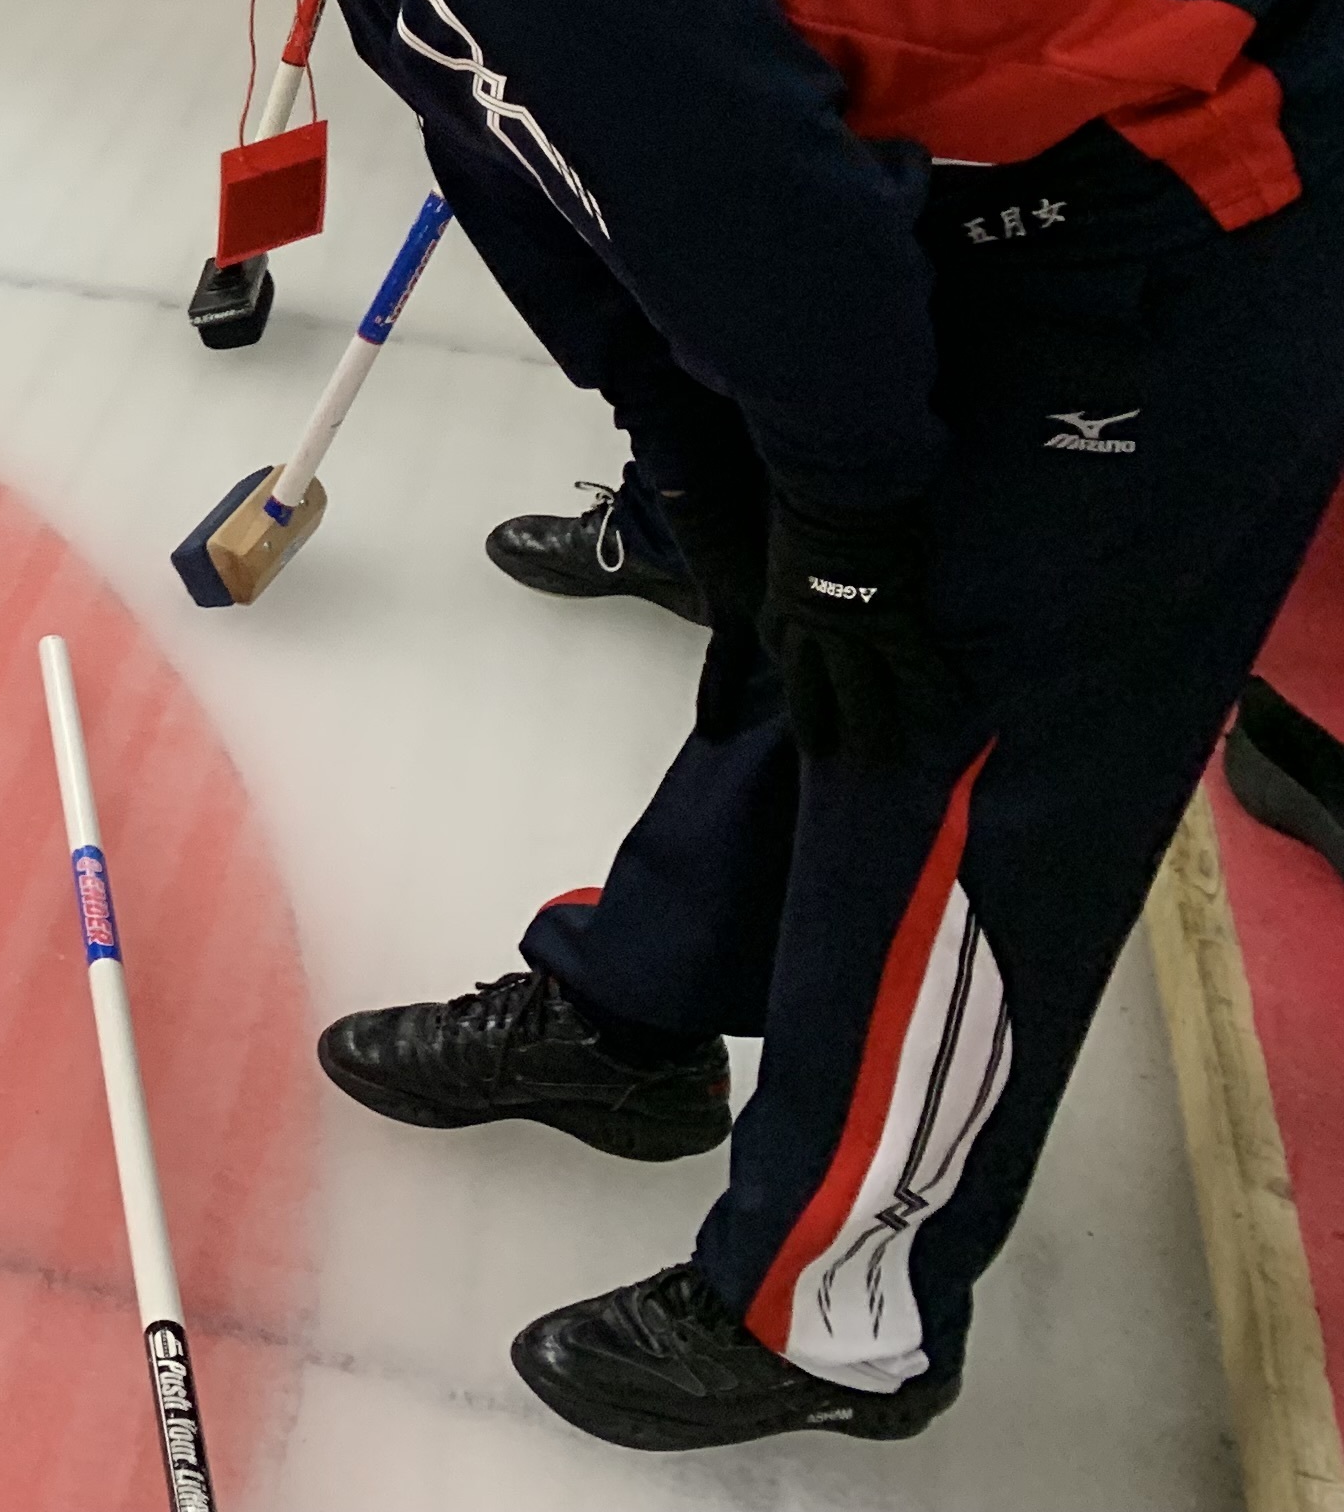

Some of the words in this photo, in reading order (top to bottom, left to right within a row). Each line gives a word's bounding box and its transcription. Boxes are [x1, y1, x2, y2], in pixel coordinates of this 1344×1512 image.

[963, 198, 1068, 244] 五月女
[157, 1359, 193, 1411] Push
